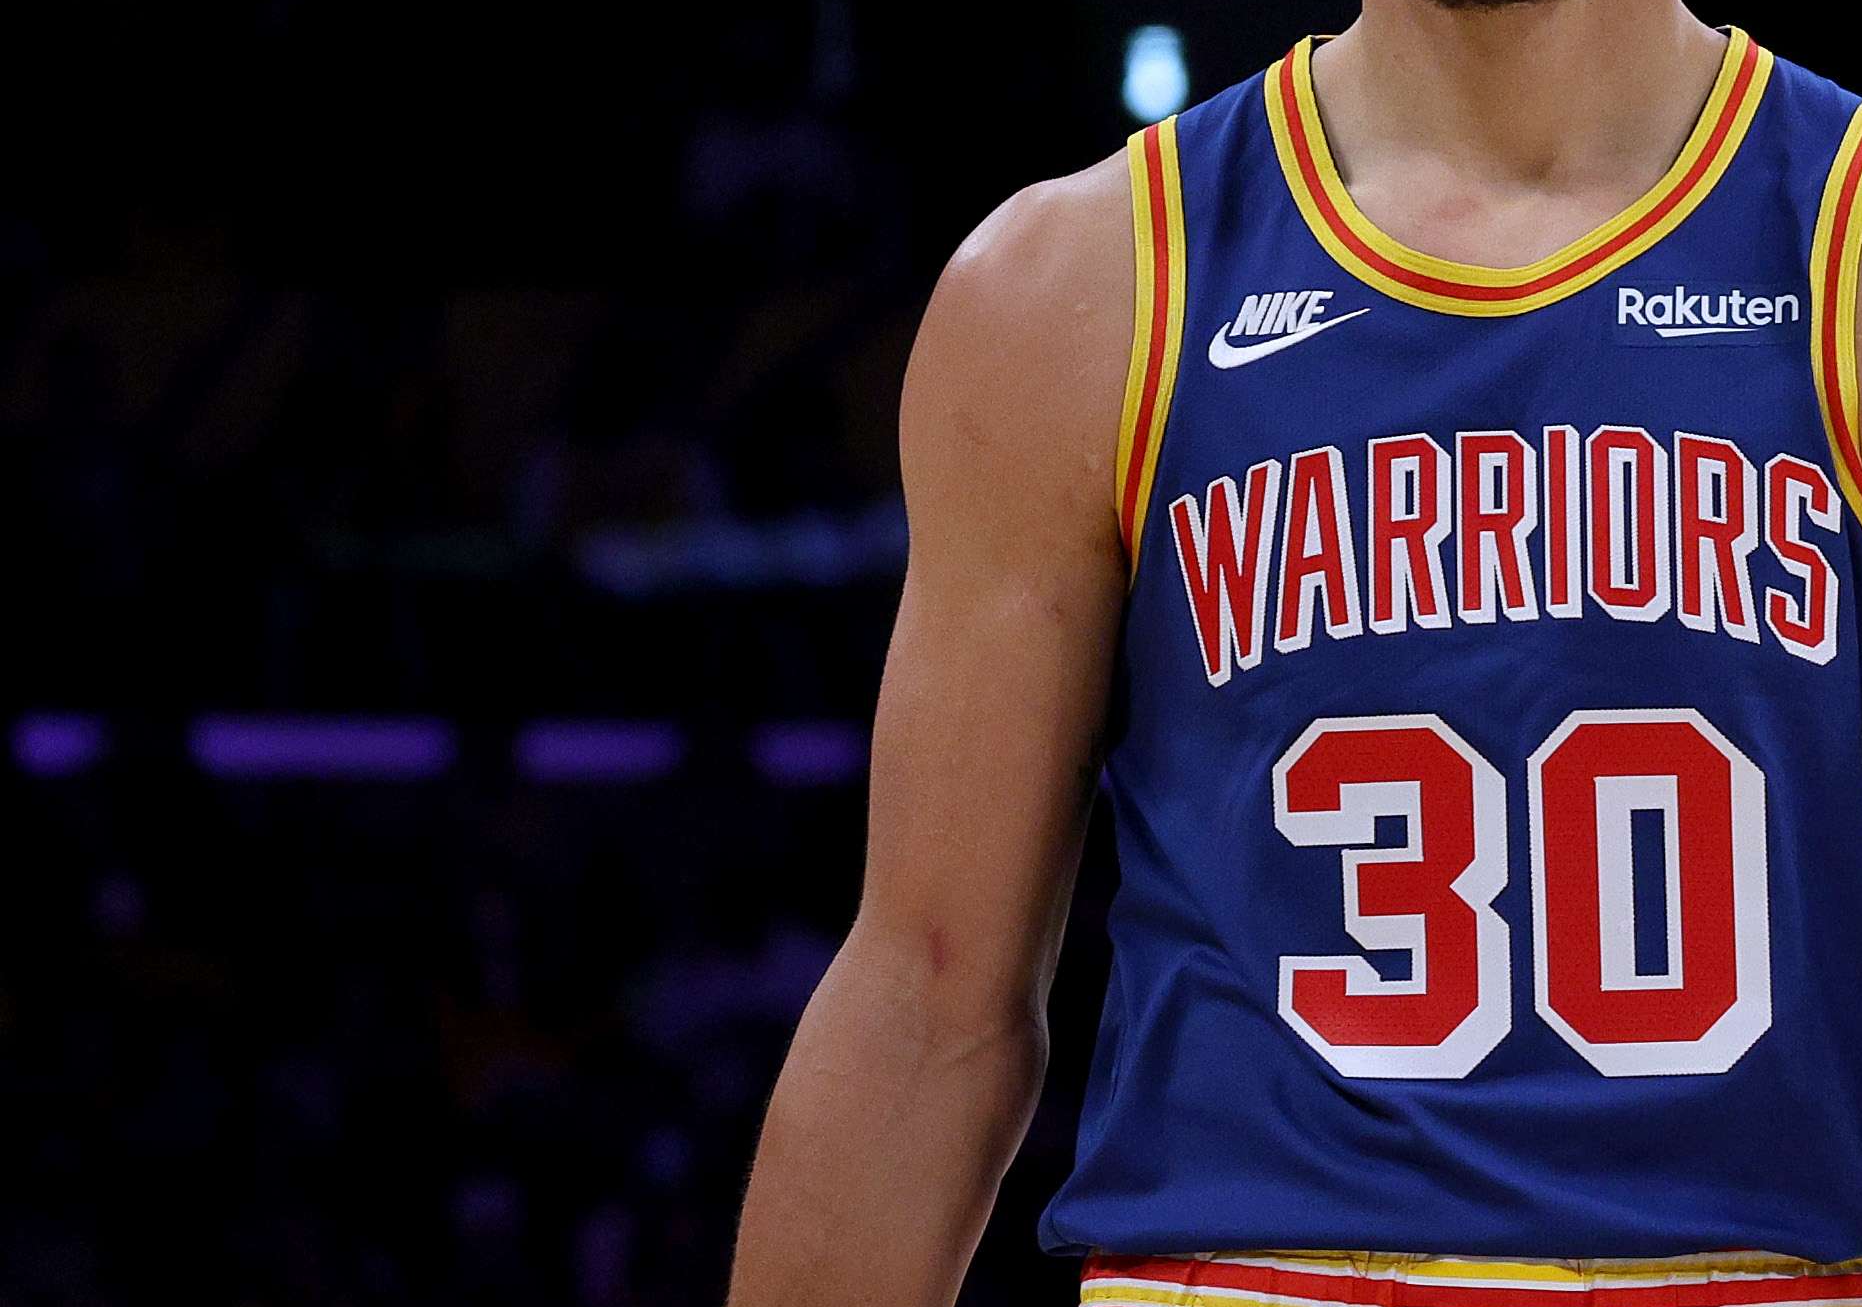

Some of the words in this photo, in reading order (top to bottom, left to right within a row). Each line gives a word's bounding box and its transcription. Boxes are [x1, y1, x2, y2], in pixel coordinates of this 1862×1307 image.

[1229, 290, 1334, 337] NIKE
[1617, 285, 1800, 327] Rakuten
[1168, 424, 1843, 688] WARRIORS
[1272, 708, 1773, 1080] 30
